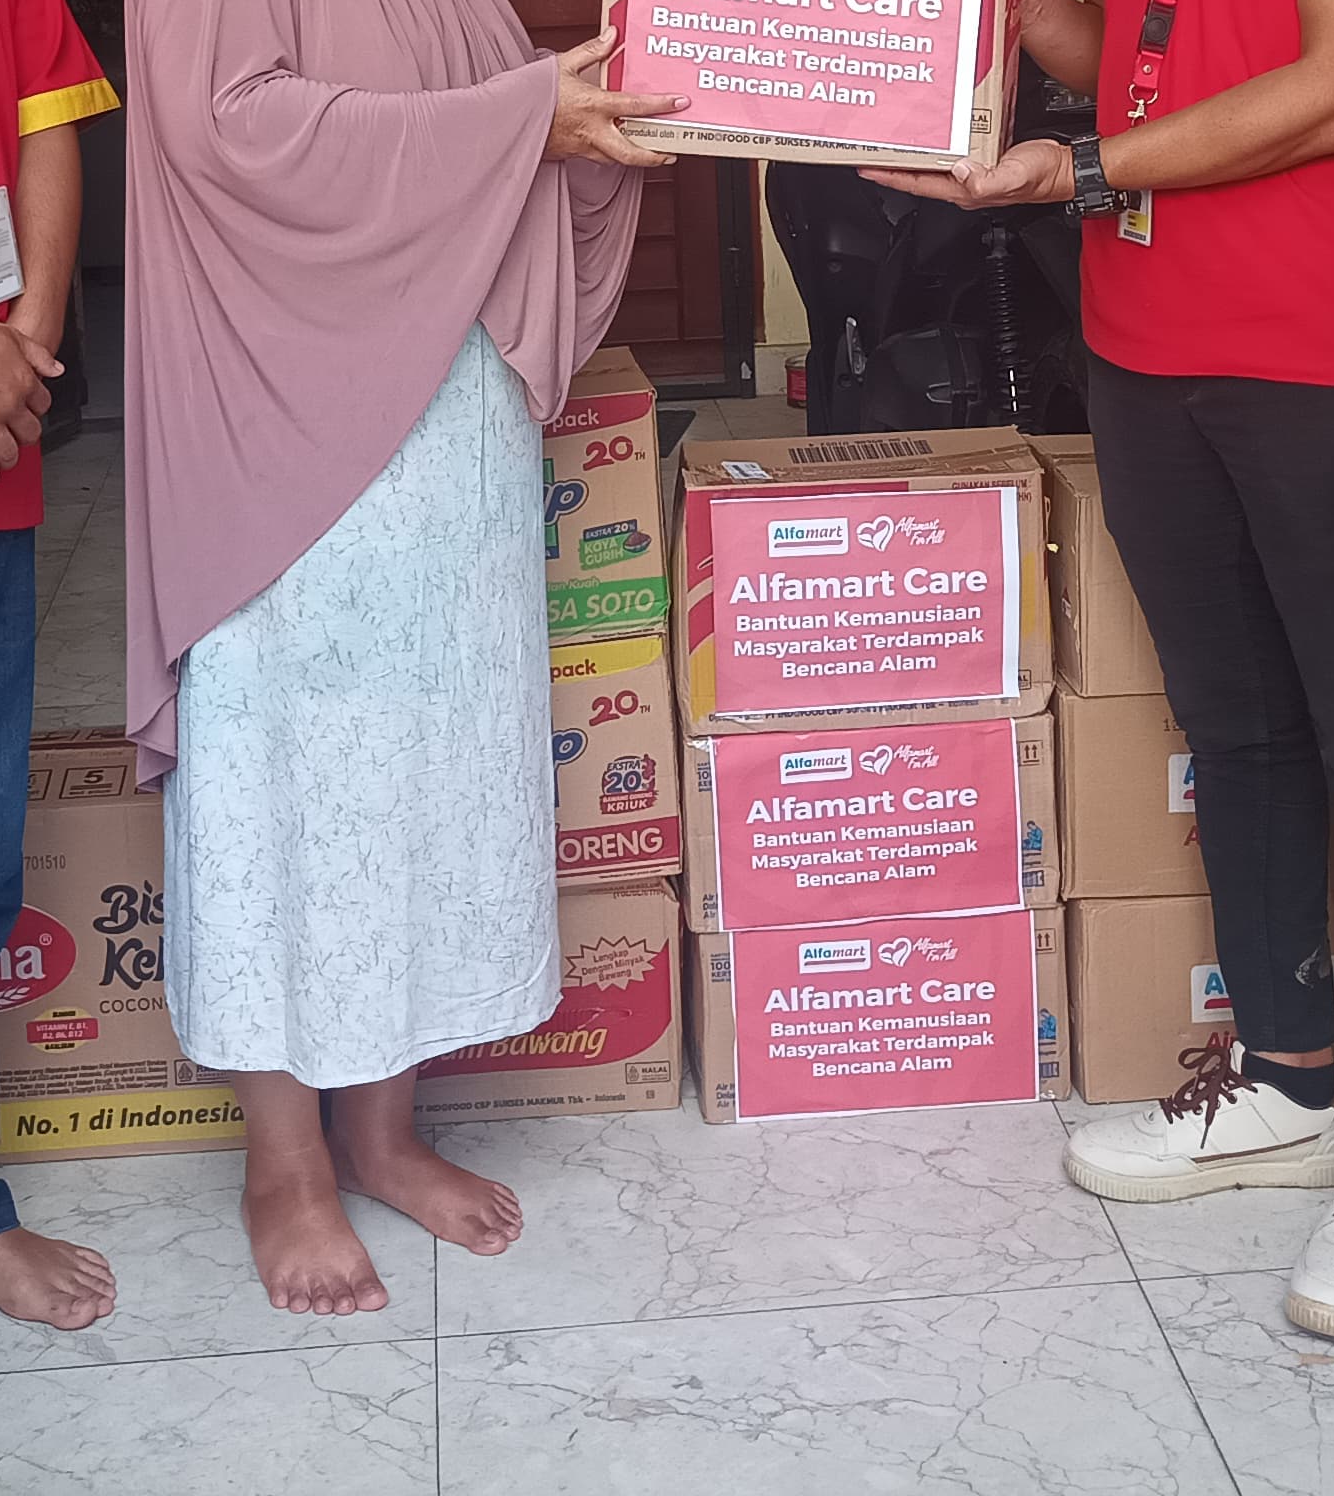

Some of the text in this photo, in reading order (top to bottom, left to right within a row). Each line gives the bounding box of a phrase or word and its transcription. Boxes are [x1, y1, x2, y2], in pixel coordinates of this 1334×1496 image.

[652, 7, 933, 54] Bantuan Kemanusiaan
[646, 36, 934, 85] Masyarakat Terdampak
[698, 69, 876, 106] Bencana Alam
[683, 131, 694, 140] PT
[582, 435, 634, 472] 20
[773, 524, 843, 541] Alfamart
[894, 516, 940, 534] Alfamart
[927, 529, 946, 545] All
[584, 539, 618, 554] KOYA
[585, 550, 624, 565] GURIH
[730, 567, 988, 605] Alfamart Care
[585, 588, 655, 618] SOTO
[735, 603, 981, 633] Bantuan Kemanusiaan
[733, 627, 984, 658] Masyarakat Terdampak
[781, 653, 936, 679] Bencana Alam
[589, 690, 639, 727] 20
[607, 759, 642, 772] EKSTRA
[785, 754, 847, 770] Alfamart
[83, 770, 104, 784] 5
[606, 798, 648, 813] KRIUK
[746, 788, 978, 825] Alfamart Care
[752, 817, 974, 848] Bantuan Kemanusiaan
[751, 838, 978, 871] Masyarakat Terdampak
[796, 861, 936, 888] Bencana Alam
[581, 955, 645, 976] Dengan Minyak
[593, 950, 629, 963] Lengkap
[804, 945, 866, 960] Alfamart
[598, 969, 632, 982] Bawang
[765, 979, 996, 1013] Alfamart Care
[770, 1009, 991, 1038] Bantuan Kemanusiaan
[490, 1027, 607, 1059] Bawang
[769, 1030, 995, 1061] Masyarakat Terdampak
[812, 1055, 952, 1077] Bencana Alam
[526, 1096, 565, 1108] MAKMUR
[567, 1095, 585, 1104] Tbk
[17, 1100, 246, 1136] No. 1 di Indonesia
